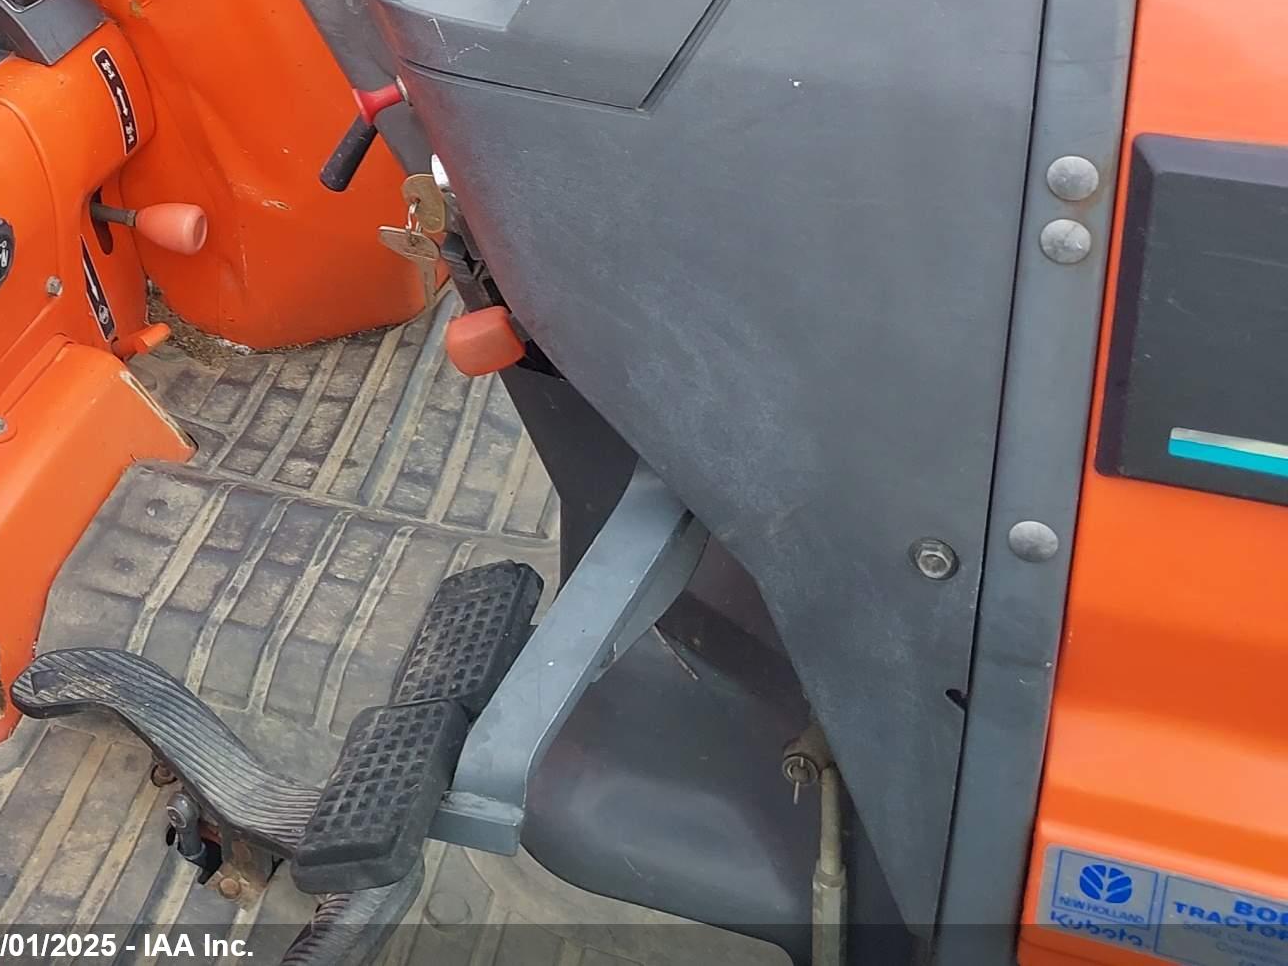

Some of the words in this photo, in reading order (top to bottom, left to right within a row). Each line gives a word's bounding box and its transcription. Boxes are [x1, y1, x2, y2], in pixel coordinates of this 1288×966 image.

[1059, 896, 1086, 911] NEW
[1087, 902, 1144, 923] HOLLAND
[1051, 910, 1143, 947] Kubota
